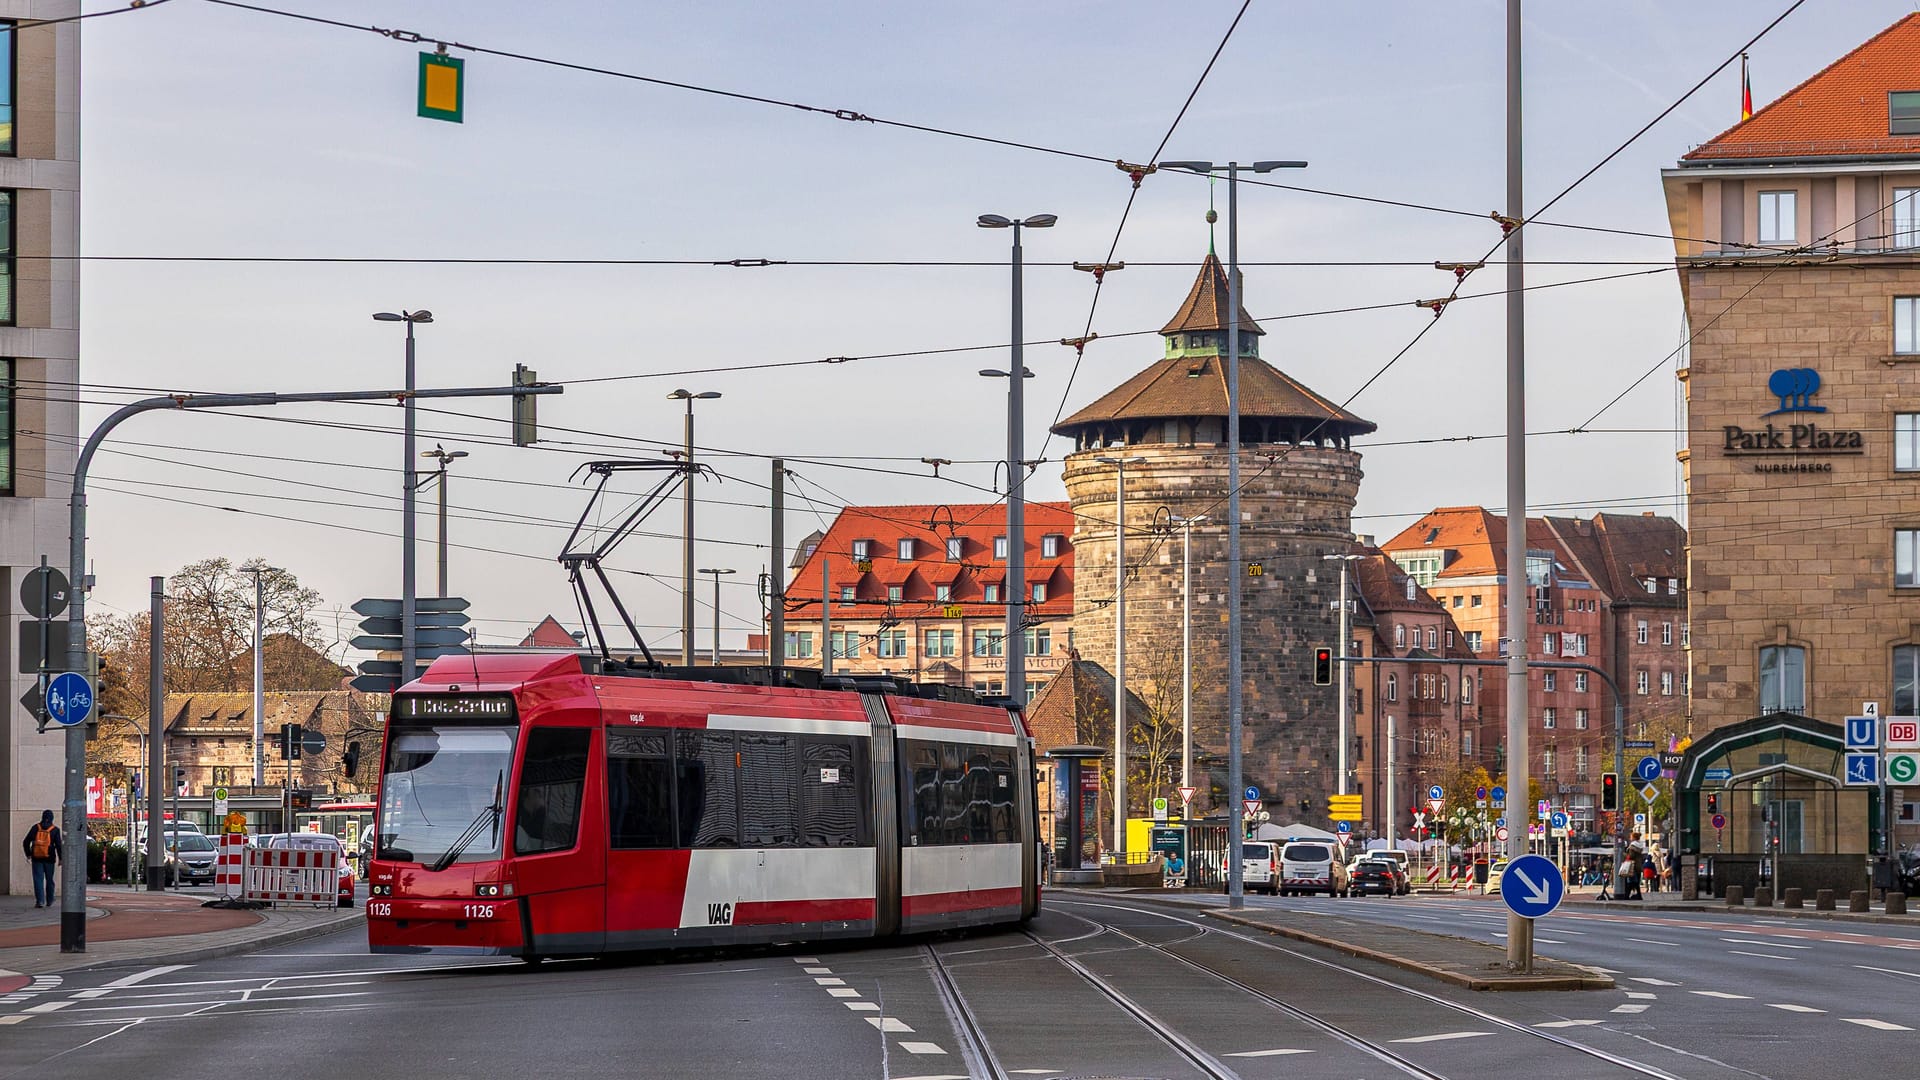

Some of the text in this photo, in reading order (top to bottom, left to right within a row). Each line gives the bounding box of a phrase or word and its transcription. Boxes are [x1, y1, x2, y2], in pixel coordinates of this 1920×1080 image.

[1723, 423, 1863, 450] Park Plaza
[1755, 463, 1832, 473] NUREMBERG
[1249, 565, 1262, 576] 270
[1866, 703, 1876, 715] 4
[1852, 721, 1871, 744] U
[1892, 726, 1914, 739] DB
[1895, 759, 1912, 778] S
[369, 903, 391, 916] 1126
[464, 905, 494, 918] 1126
[708, 903, 732, 925] VAG
